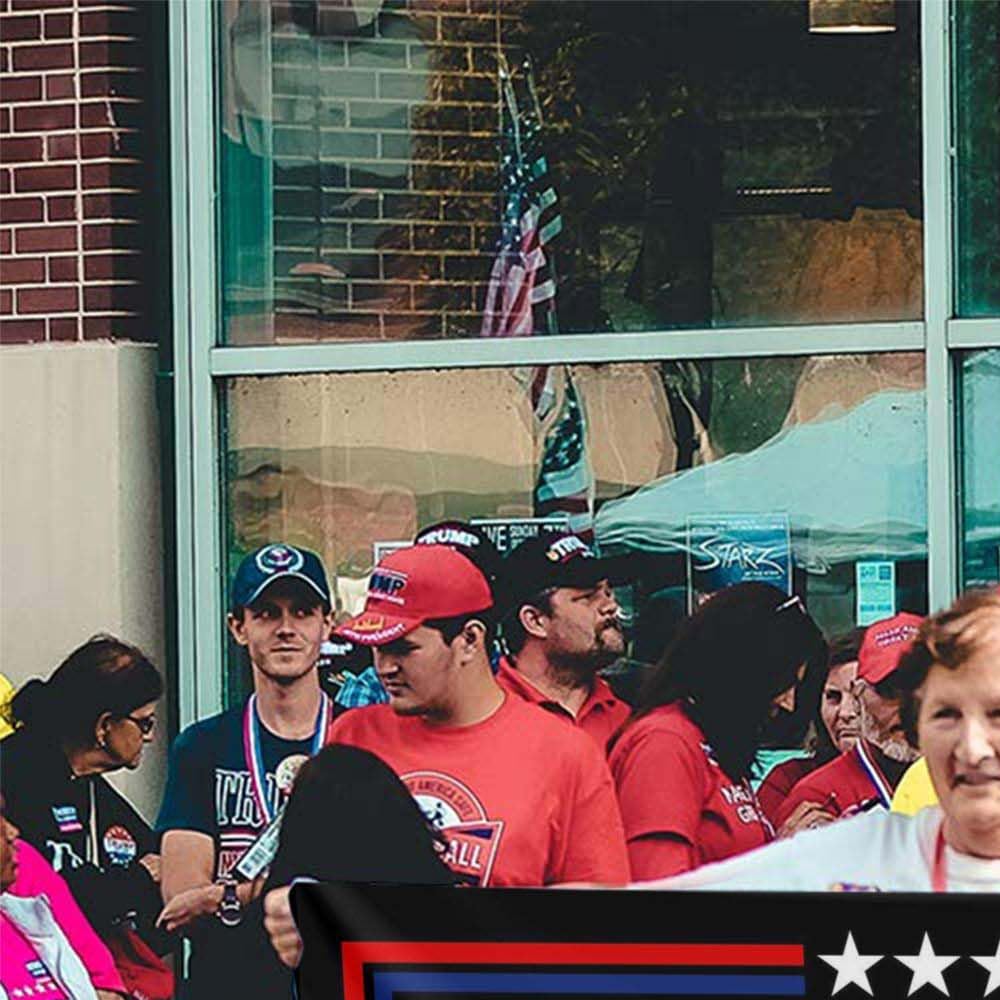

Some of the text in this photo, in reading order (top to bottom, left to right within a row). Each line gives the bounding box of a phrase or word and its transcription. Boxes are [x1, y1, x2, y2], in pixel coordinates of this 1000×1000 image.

[416, 528, 481, 548] TRUMP
[694, 537, 785, 575] STARZ
[438, 839, 482, 869] ALL
